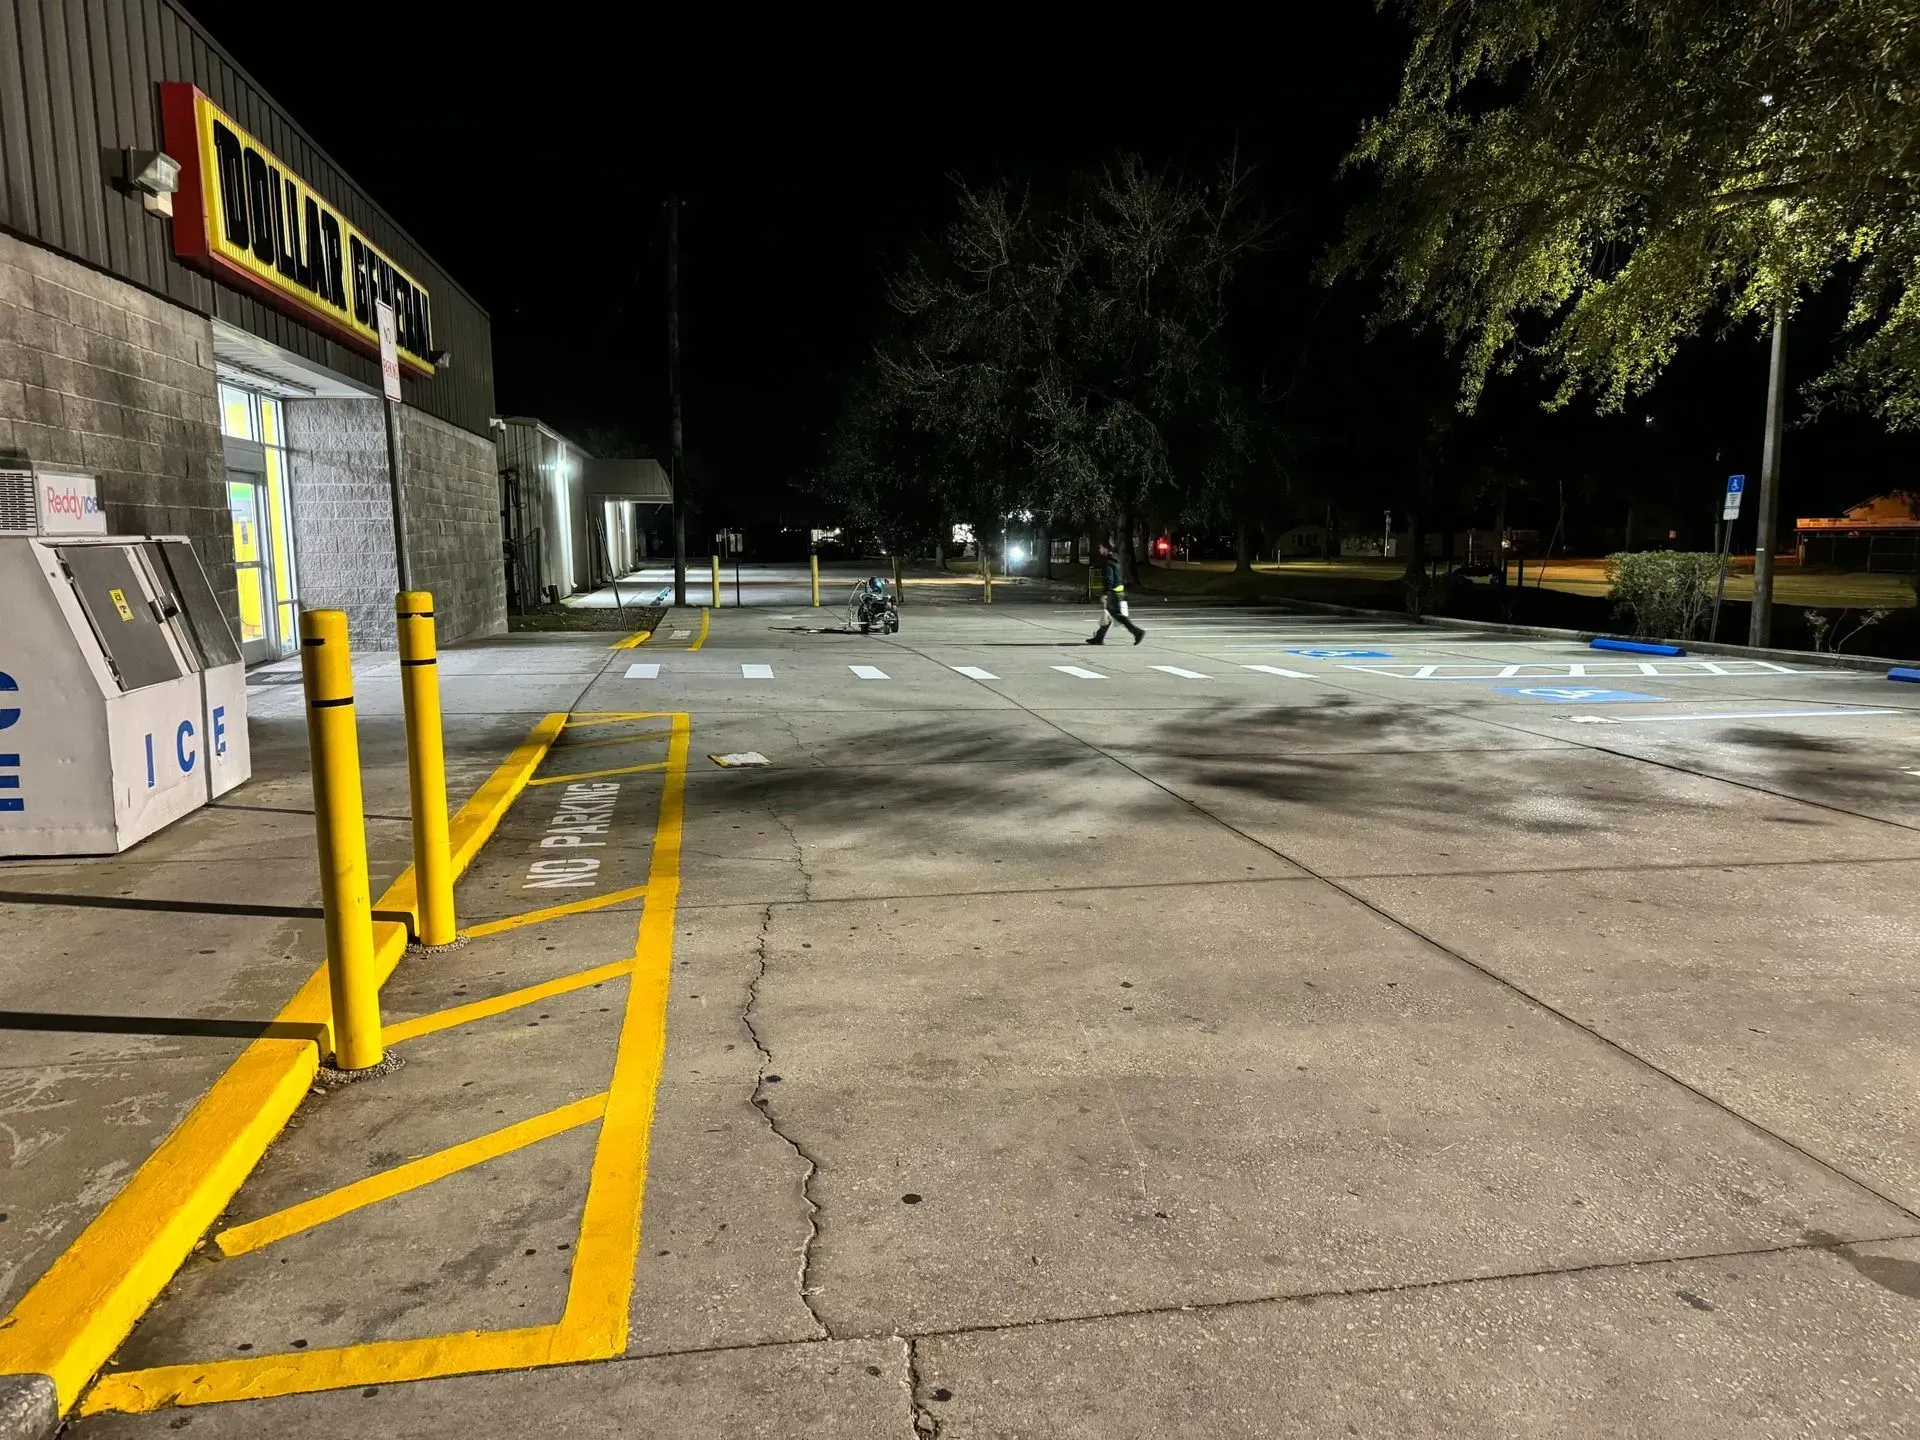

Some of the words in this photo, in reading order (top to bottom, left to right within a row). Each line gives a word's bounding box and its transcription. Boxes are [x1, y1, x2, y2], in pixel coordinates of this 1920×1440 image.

[213, 119, 347, 313] DOLLAR
[145, 706, 227, 788] ICE
[540, 783, 620, 847] PARKING
[522, 859, 600, 888] NO
